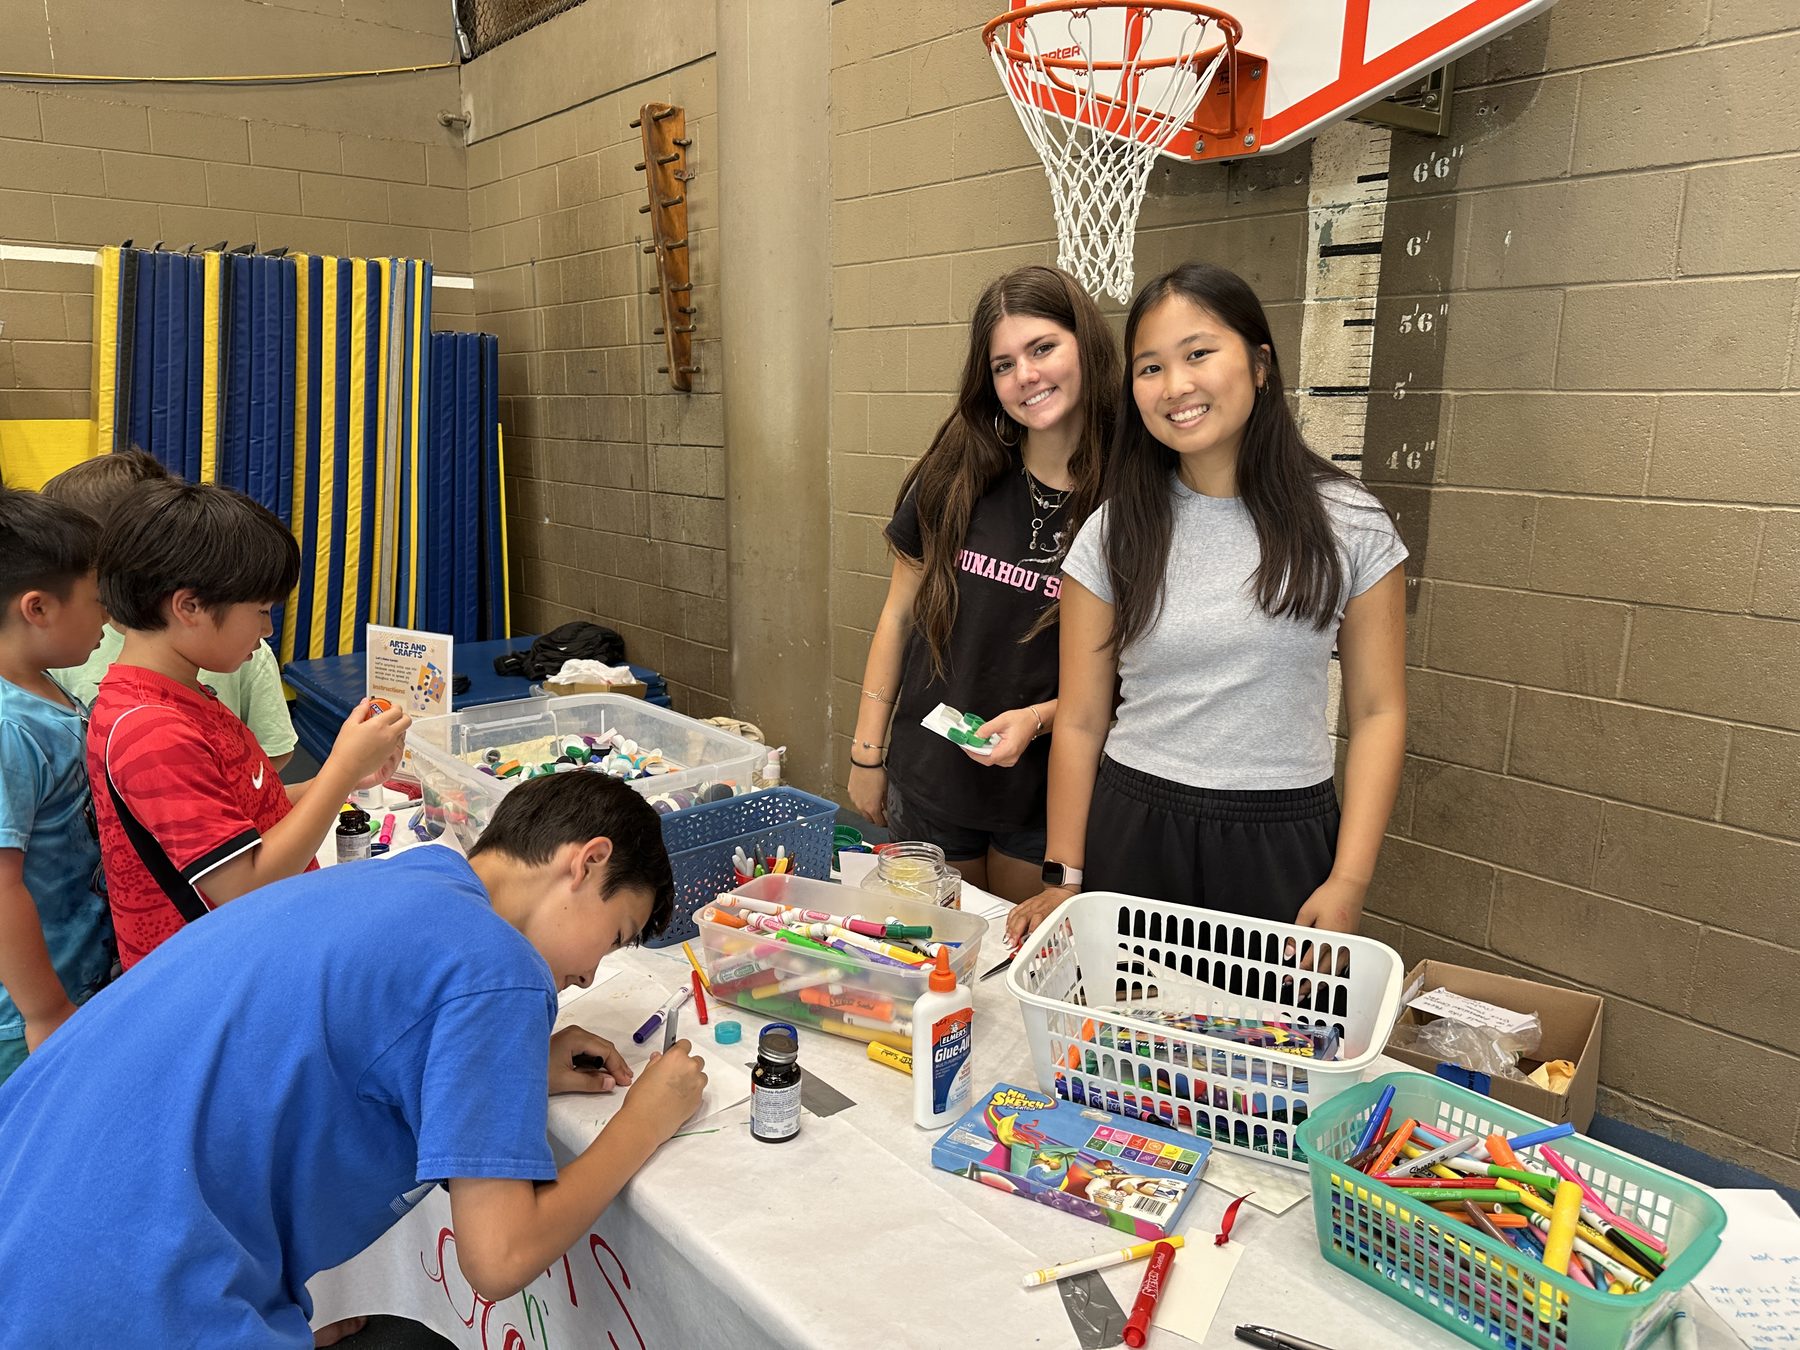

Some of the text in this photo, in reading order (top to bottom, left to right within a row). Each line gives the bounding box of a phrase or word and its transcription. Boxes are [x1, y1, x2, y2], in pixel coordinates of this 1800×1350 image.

[389, 640, 427, 652] ARTS AND
[393, 648, 423, 659] CRAFTS
[941, 1029, 967, 1045] ELMER'S
[989, 1091, 1046, 1109] SKETCH
